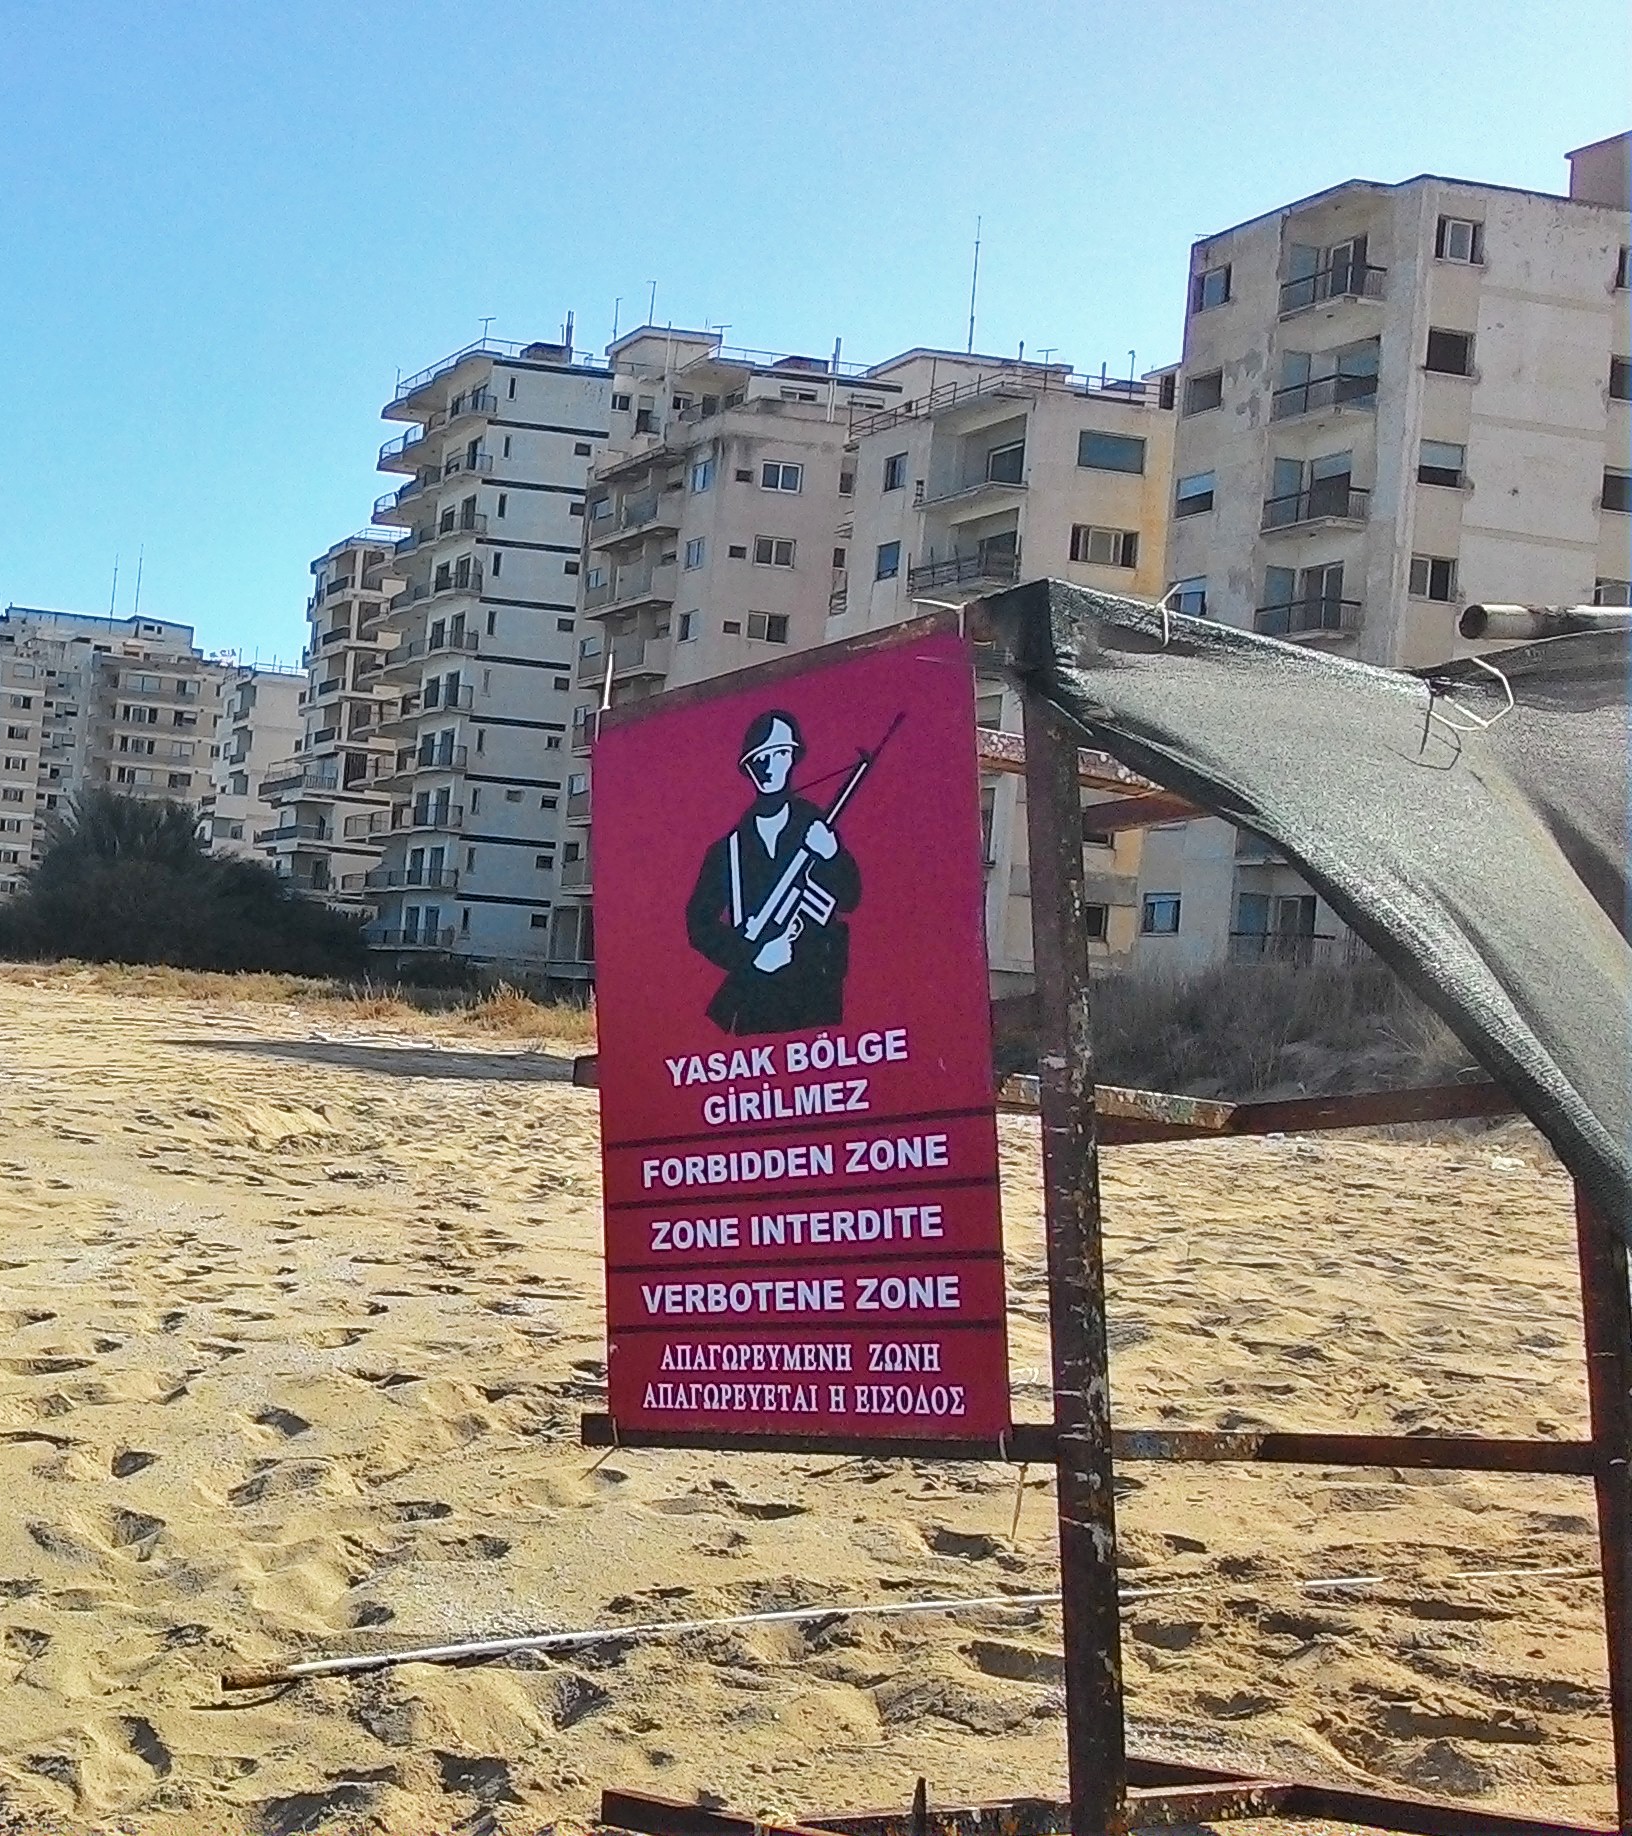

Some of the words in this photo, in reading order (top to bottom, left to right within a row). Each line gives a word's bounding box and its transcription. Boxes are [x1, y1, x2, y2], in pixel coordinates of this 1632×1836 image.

[665, 1045, 777, 1087] YASAK
[786, 1028, 908, 1073] BÖLGE
[704, 1079, 870, 1125] GİRİLMEZ
[643, 1144, 834, 1188] FORBIDDEN
[845, 1134, 949, 1173] ZONE
[651, 1217, 740, 1250] ZONE
[750, 1205, 943, 1246] INTERDITE
[641, 1279, 845, 1314] VERBOTENE
[856, 1275, 961, 1310] ZONE
[660, 1343, 853, 1372] ΑΠΑΓΩΡΕΥΜΕΝΗ
[868, 1343, 941, 1372] ΖΩΝΗ
[642, 1382, 819, 1413] ΑΠΑΓΩΡΕΥΕΤΑΙ
[828, 1385, 846, 1413] Η
[854, 1384, 965, 1415] ΕΙΣΟΔΟΣ
